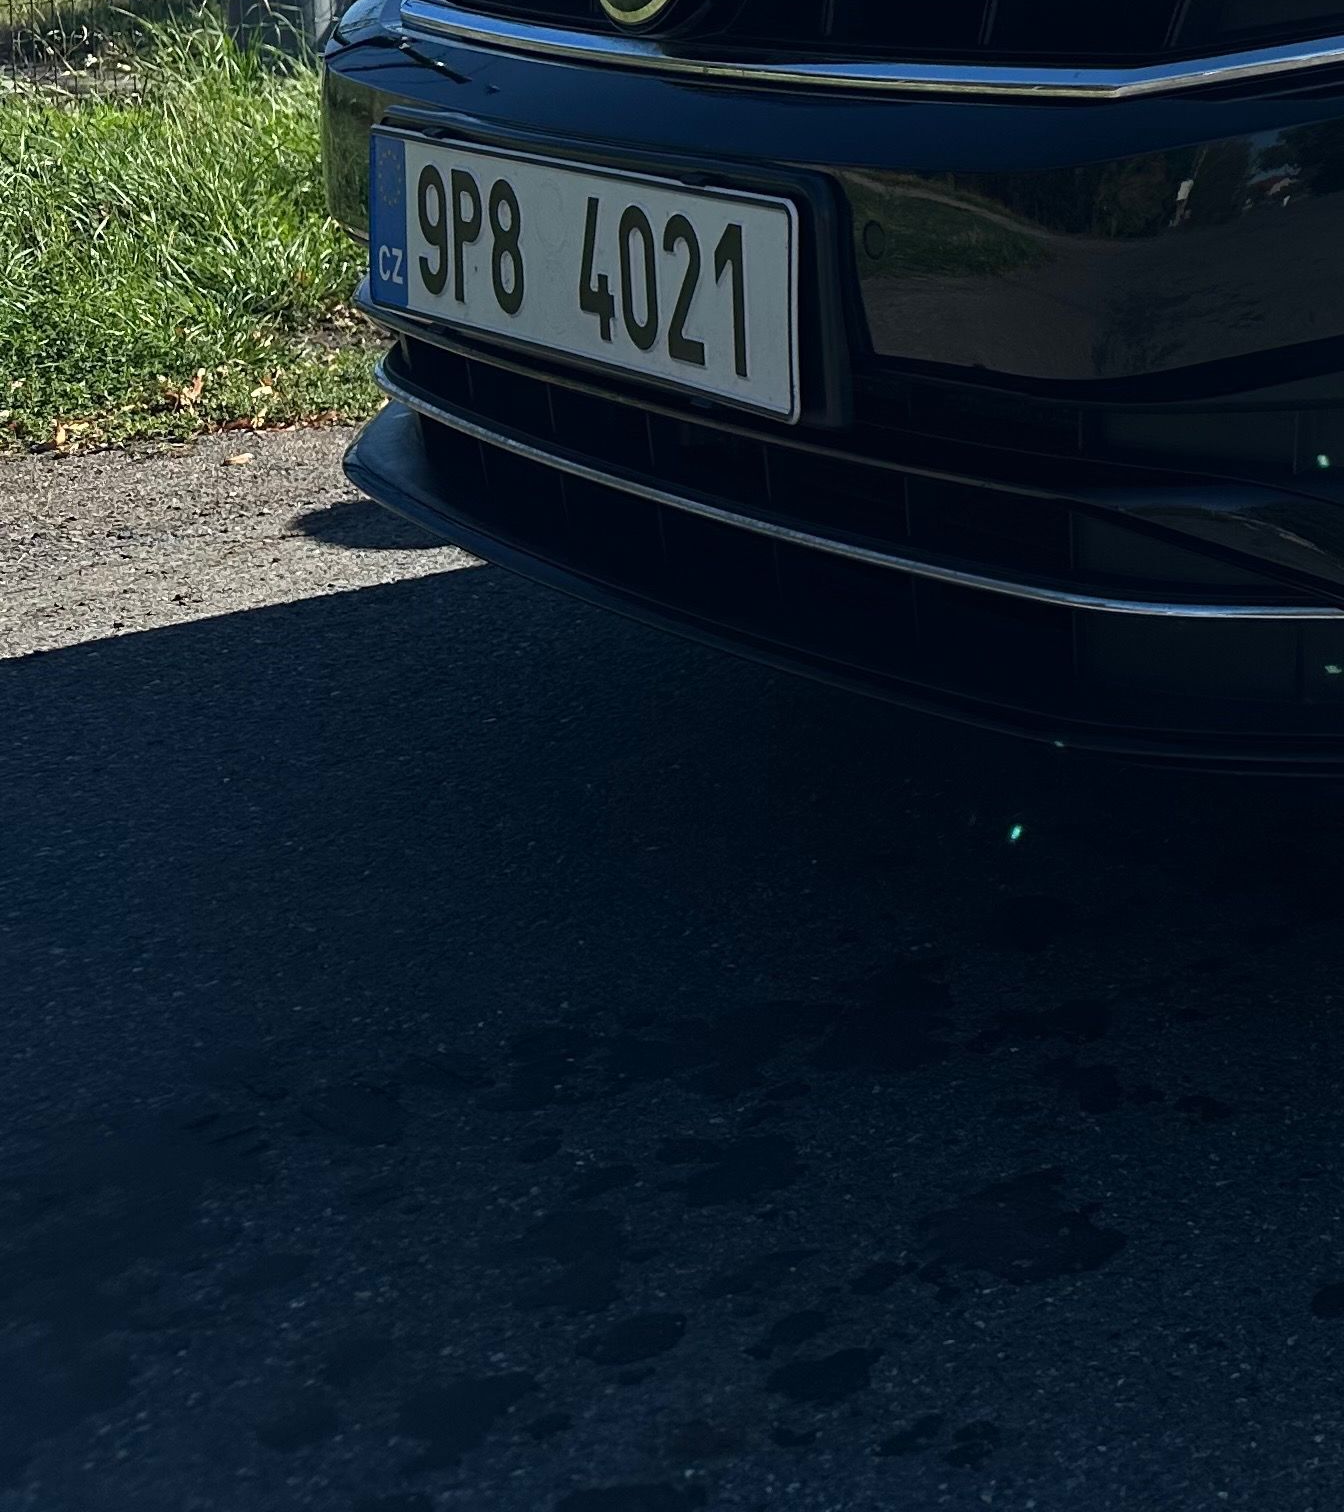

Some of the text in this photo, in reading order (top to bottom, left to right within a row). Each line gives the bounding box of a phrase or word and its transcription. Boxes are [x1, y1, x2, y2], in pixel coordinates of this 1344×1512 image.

[379, 164, 748, 378] CZ 9P8 4021
